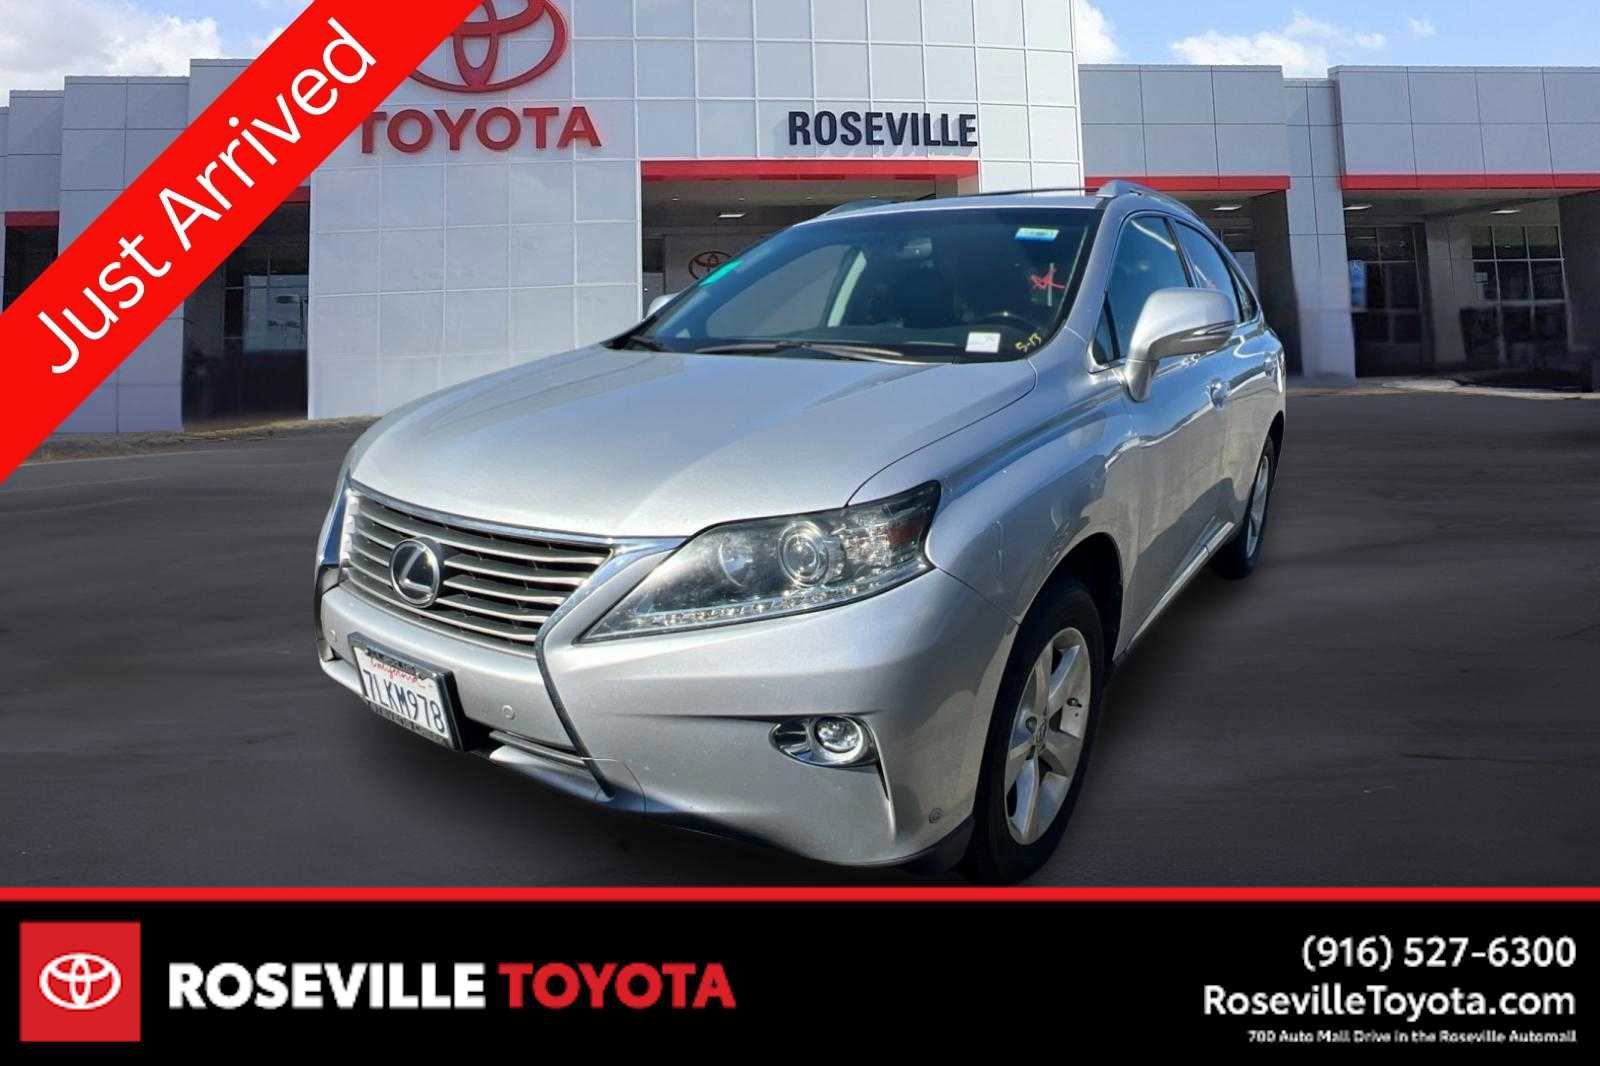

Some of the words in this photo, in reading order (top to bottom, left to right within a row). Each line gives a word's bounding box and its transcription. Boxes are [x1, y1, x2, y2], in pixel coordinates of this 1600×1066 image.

[361, 106, 602, 154] TOYOTA
[788, 110, 978, 147] ROSEVILLE
[363, 669, 445, 734] 7LKM978
